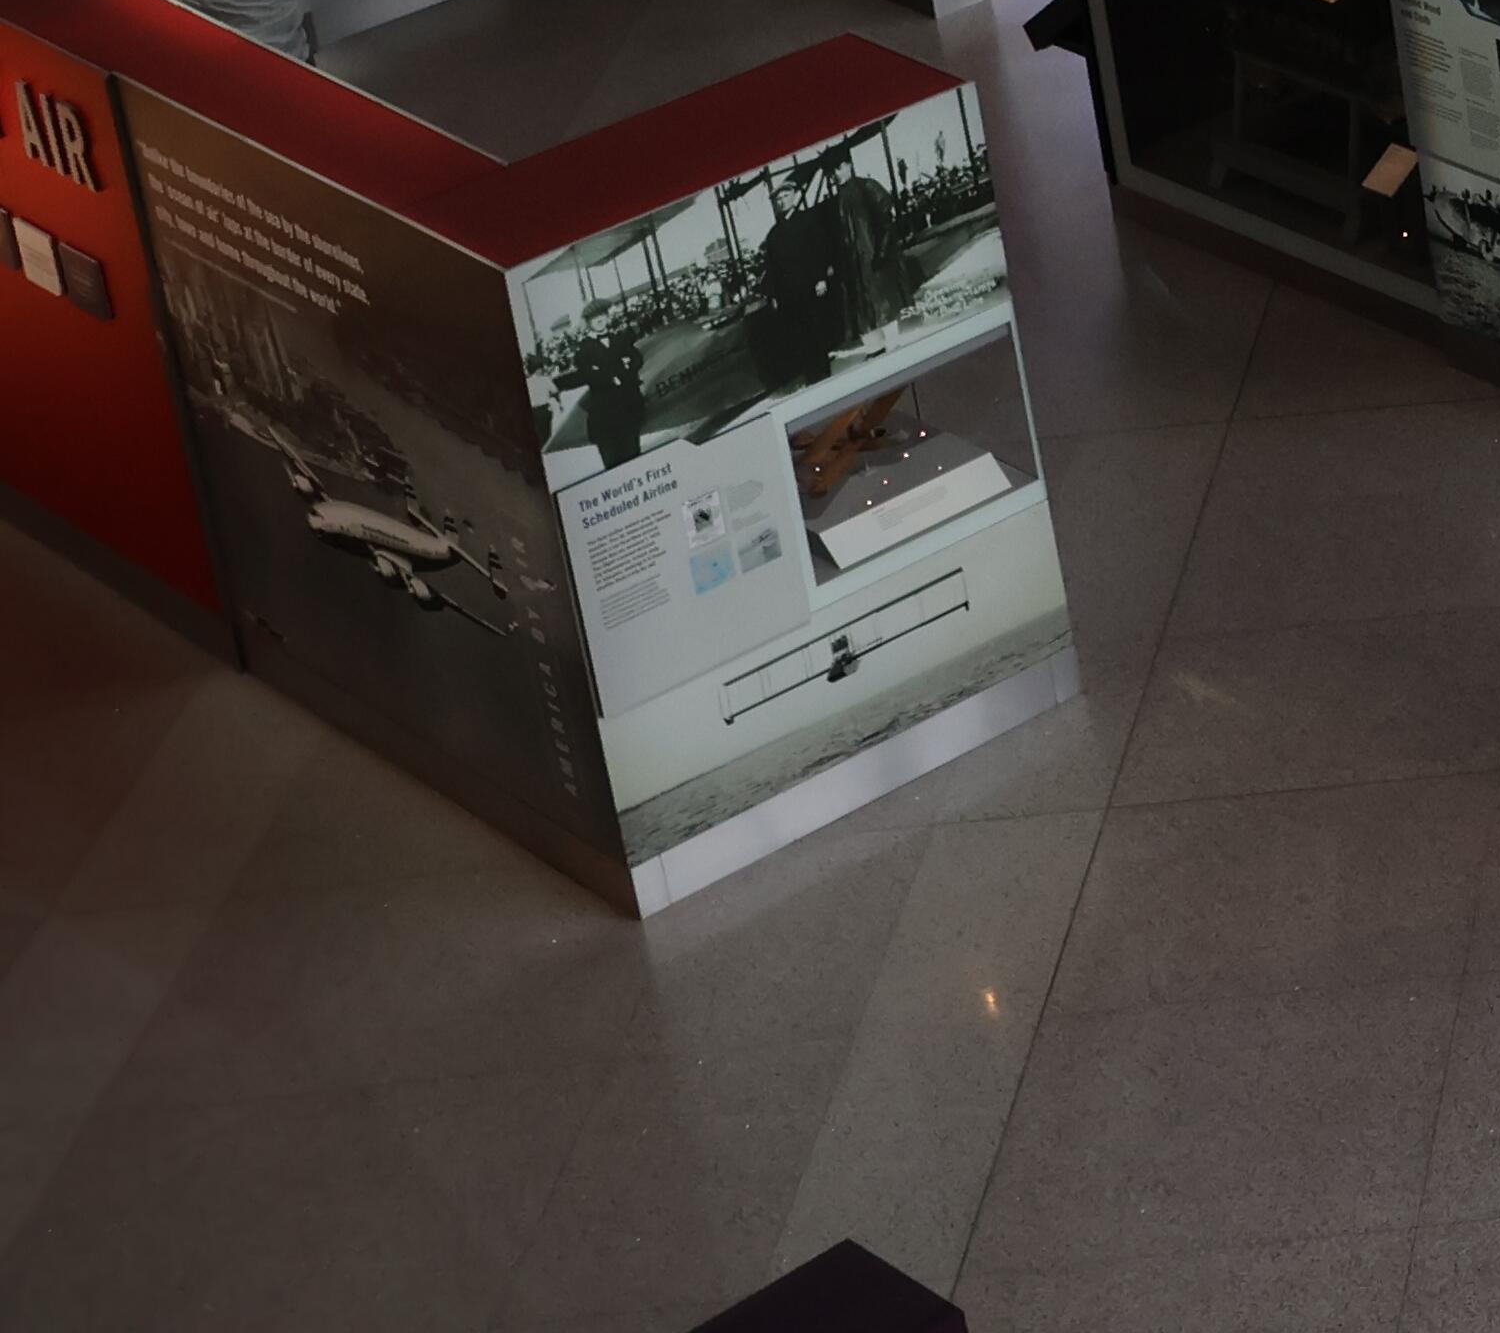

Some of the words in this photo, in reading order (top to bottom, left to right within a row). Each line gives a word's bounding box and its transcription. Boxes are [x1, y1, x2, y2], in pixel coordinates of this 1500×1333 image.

[15, 79, 98, 193] AIR
[578, 497, 599, 513] The
[600, 477, 644, 502] World's
[645, 462, 673, 484] First
[581, 497, 641, 530] Scheduled
[642, 479, 679, 504] Airline
